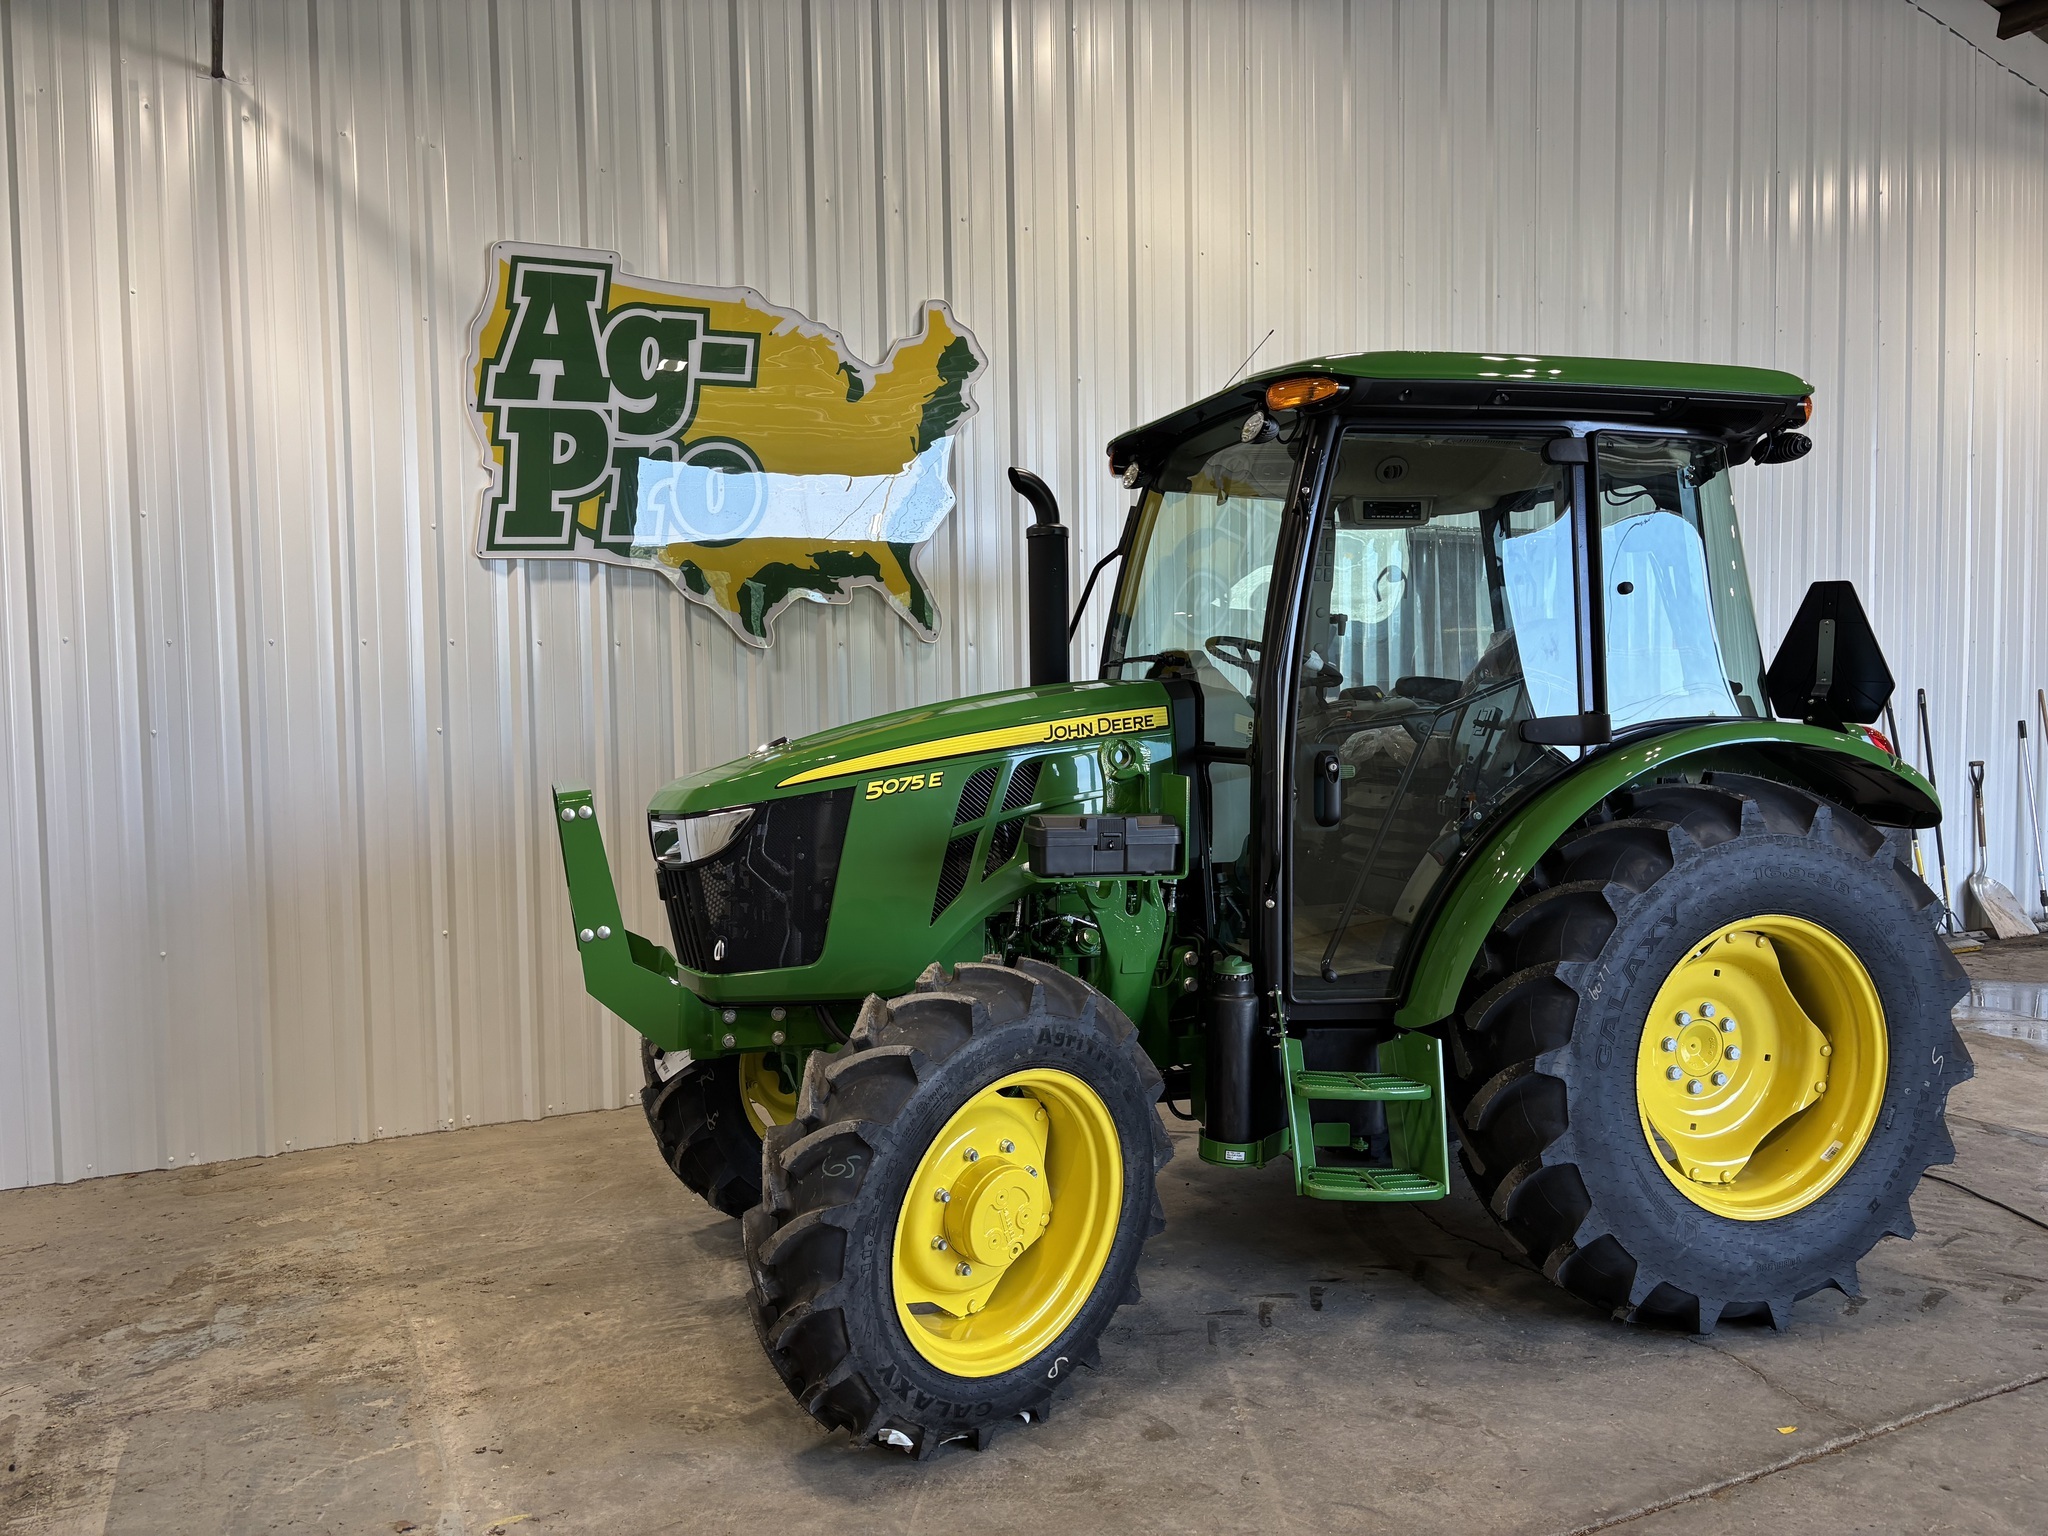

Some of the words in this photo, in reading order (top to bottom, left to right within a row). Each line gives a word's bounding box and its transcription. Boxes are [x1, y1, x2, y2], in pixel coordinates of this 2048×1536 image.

[485, 262, 755, 440] Ag-
[494, 405, 763, 544] Pro
[1044, 721, 1094, 742] JOHN
[1098, 715, 1155, 735] DEERE
[865, 775, 925, 801] 5075
[928, 771, 944, 788] E
[1595, 903, 1678, 1070] GALAXY
[876, 1363, 993, 1418] GALAXY
